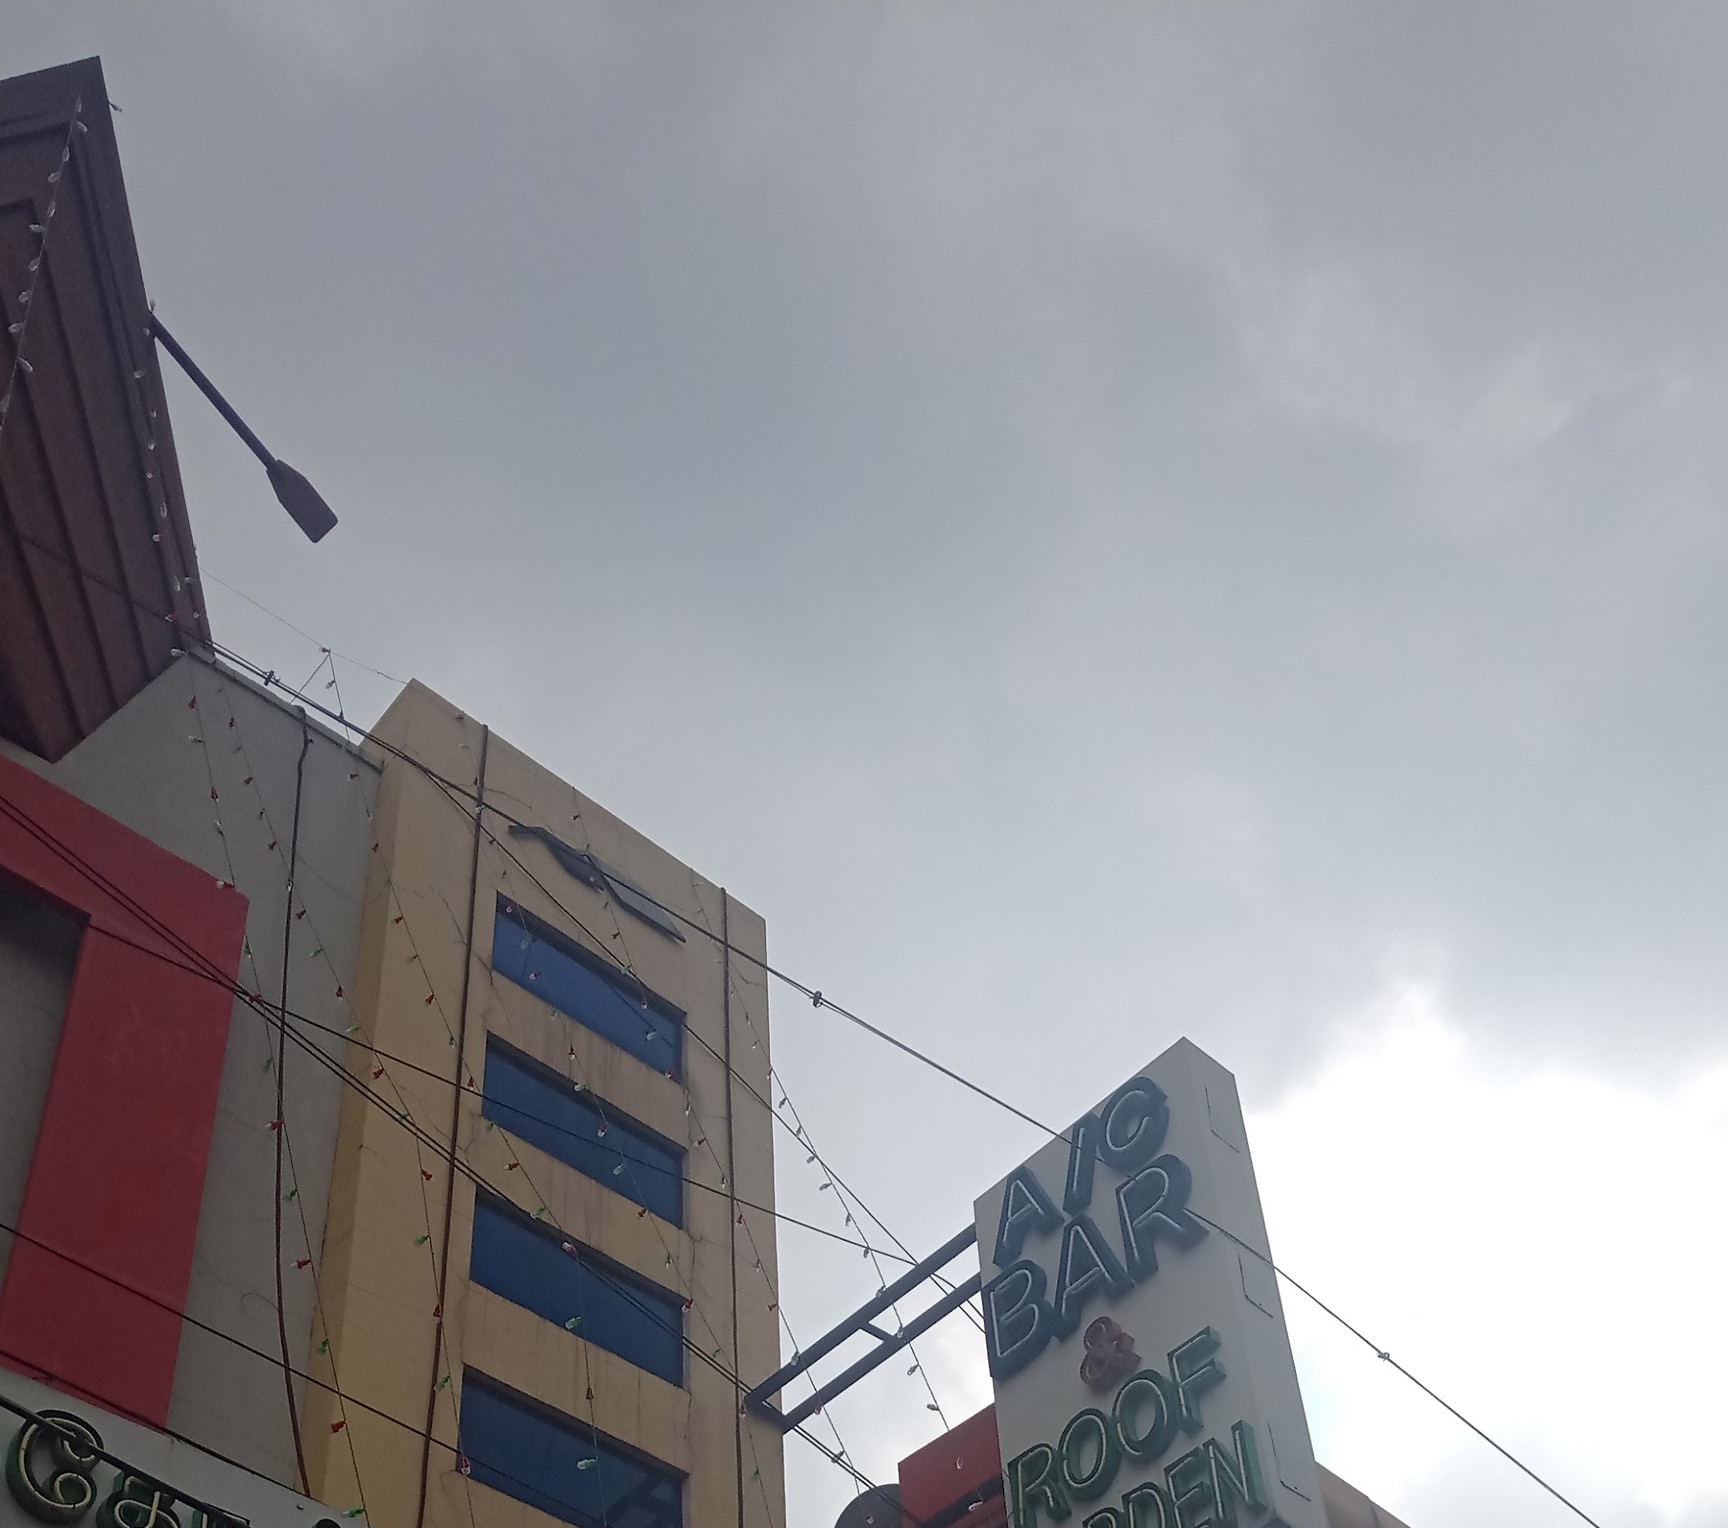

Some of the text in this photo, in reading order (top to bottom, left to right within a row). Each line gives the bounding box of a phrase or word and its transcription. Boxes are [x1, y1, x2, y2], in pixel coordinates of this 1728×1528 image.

[984, 1153, 1209, 1379] BAR
[993, 1076, 1168, 1268] A/C
[1080, 1316, 1142, 1393] &
